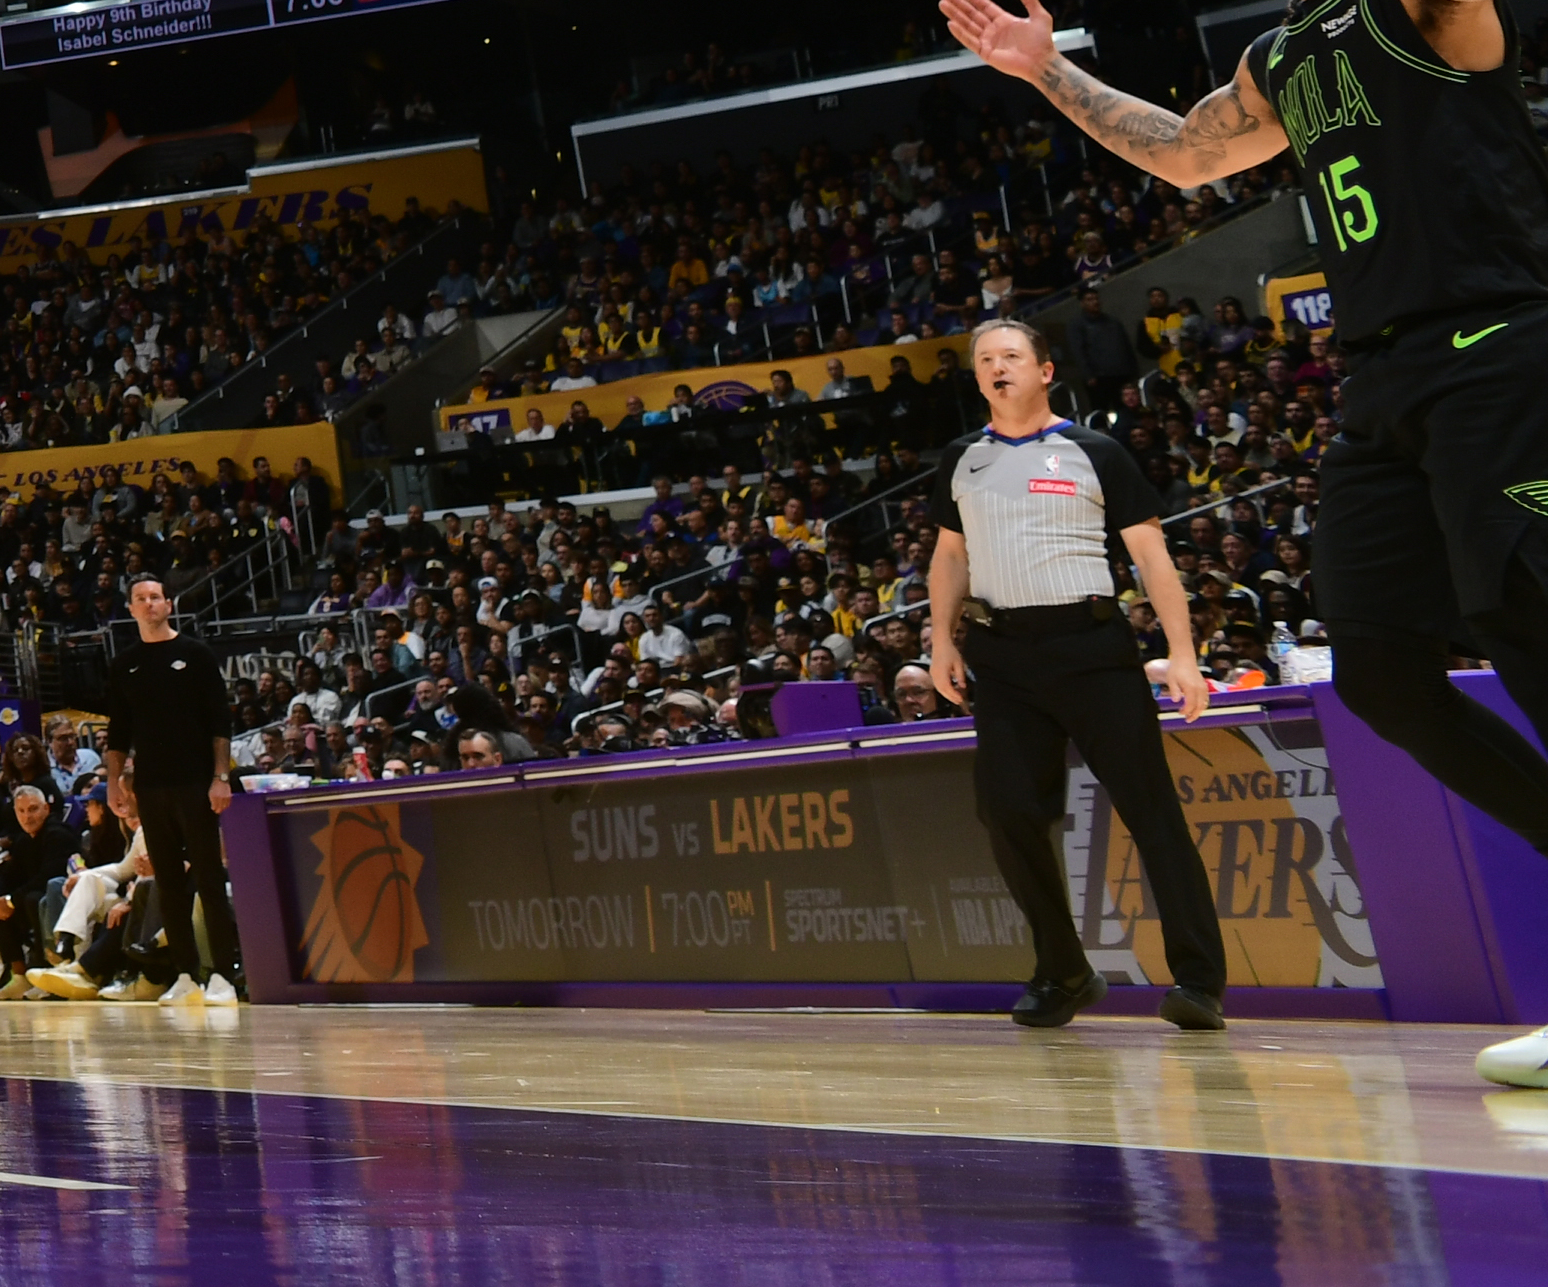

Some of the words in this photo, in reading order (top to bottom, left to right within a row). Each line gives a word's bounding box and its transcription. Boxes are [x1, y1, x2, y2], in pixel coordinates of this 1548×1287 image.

[52, 12, 102, 38] Happy
[108, 5, 137, 28] 9th
[57, 29, 106, 54] Isabel
[110, 12, 213, 48] Schneider!!!
[82, 182, 374, 248] LAKERS
[1319, 155, 1381, 254] 15
[14, 471, 45, 488] LOS
[49, 456, 183, 486] ANGELES
[1030, 481, 1075, 495] Emirates
[571, 804, 657, 863] SUNS
[710, 788, 854, 856] LAKERS
[727, 889, 754, 916] PM
[783, 888, 842, 908] SPECTRUM
[469, 894, 637, 953] TOMORROW
[662, 890, 727, 949] 7:00
[732, 919, 752, 945] PT
[785, 906, 928, 944] SPORTSNET+
